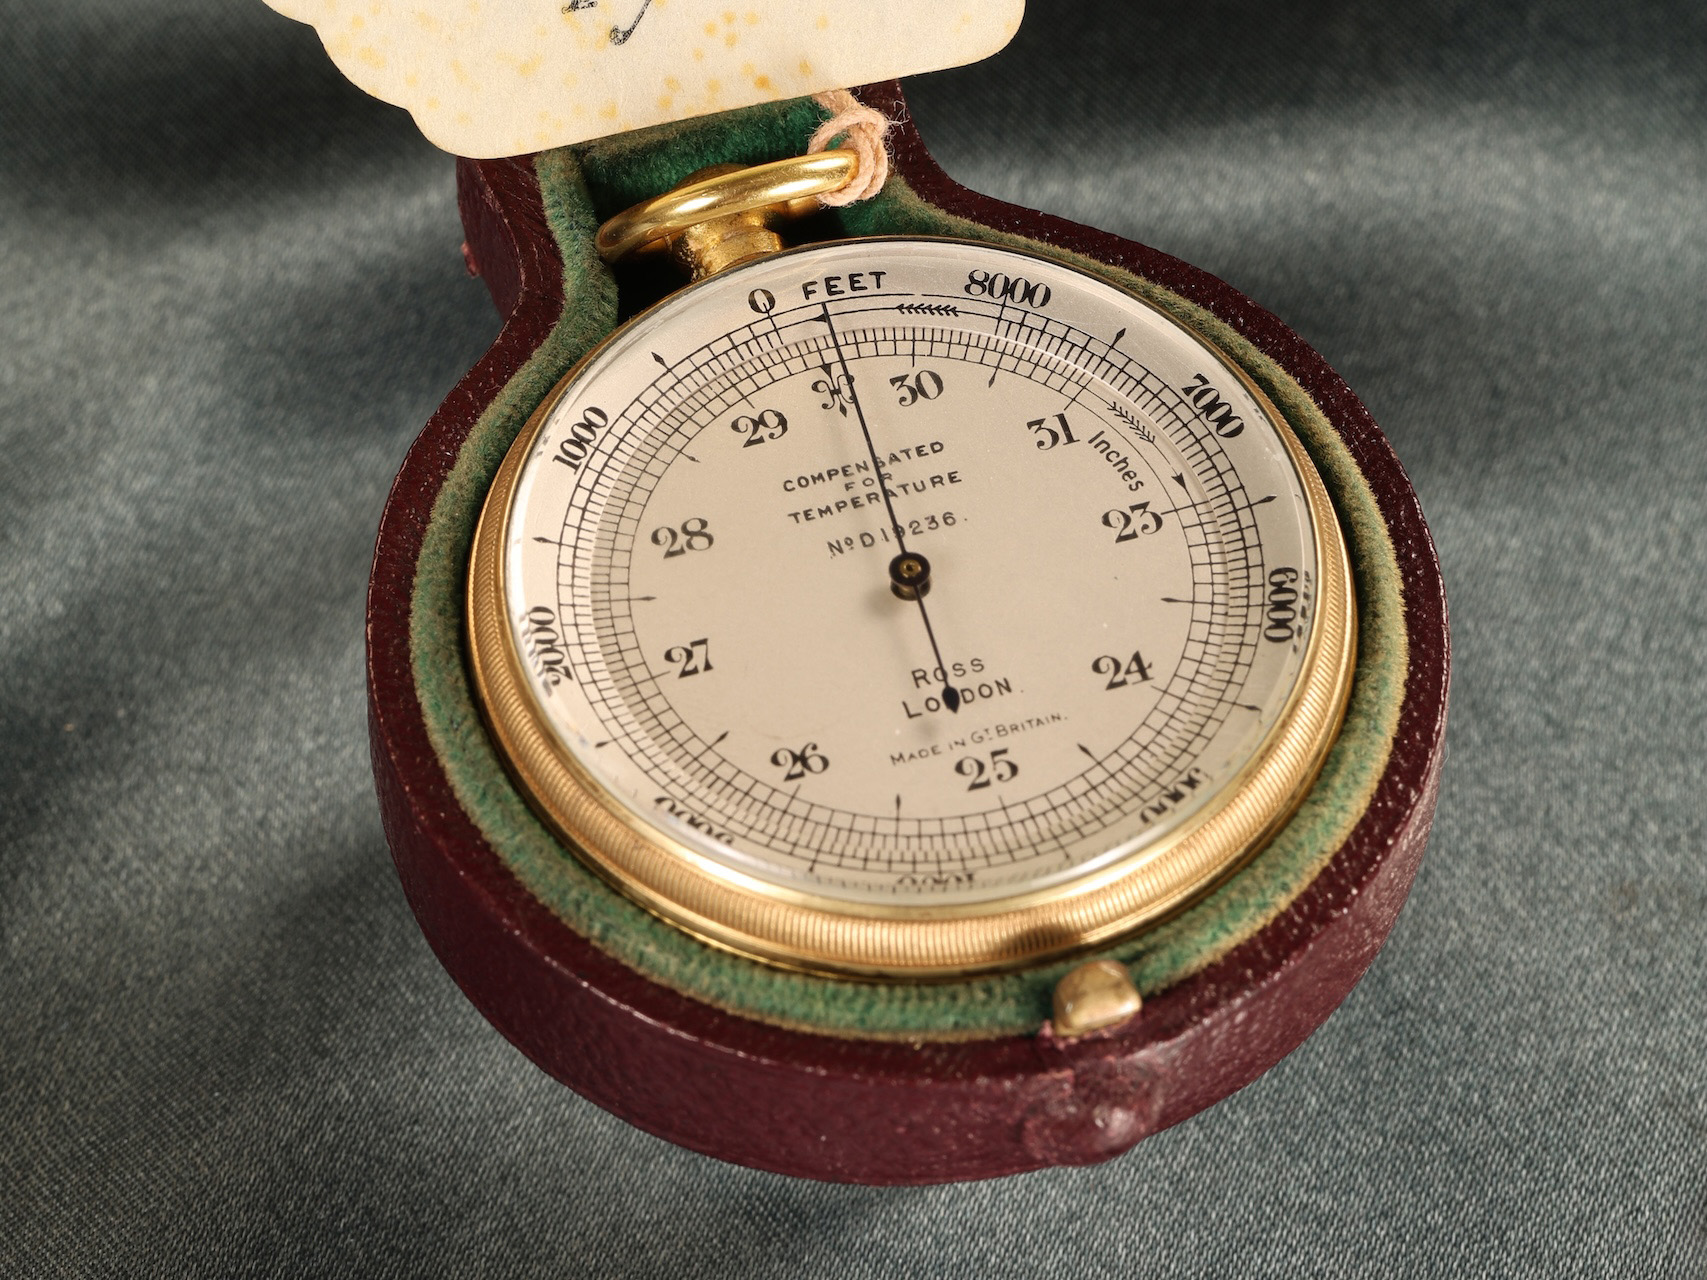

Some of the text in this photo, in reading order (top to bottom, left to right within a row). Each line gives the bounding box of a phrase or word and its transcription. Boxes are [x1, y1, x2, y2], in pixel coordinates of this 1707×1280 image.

[802, 271, 887, 300] FEET
[964, 269, 1052, 308] 8000
[890, 370, 944, 407] 30
[1181, 373, 1245, 439] 7000
[552, 406, 609, 475] 1000
[731, 409, 788, 448] 29
[1026, 412, 1080, 450] 31
[783, 441, 945, 493] COMPENSATED
[1088, 430, 1144, 492] Inches
[788, 471, 962, 524] TEMPERATURE
[844, 473, 893, 492] FOR
[651, 517, 714, 559] 28
[1101, 501, 1163, 543] 23
[1263, 566, 1298, 643] 6000
[528, 606, 573, 686] 2000
[664, 638, 714, 679] 27
[911, 658, 985, 689] ROSS
[1091, 650, 1154, 691] 24
[902, 677, 1024, 719] LODON.
[770, 742, 830, 782] 26
[889, 744, 942, 766] MADE
[949, 738, 966, 750] IN
[954, 748, 1019, 792] 25
